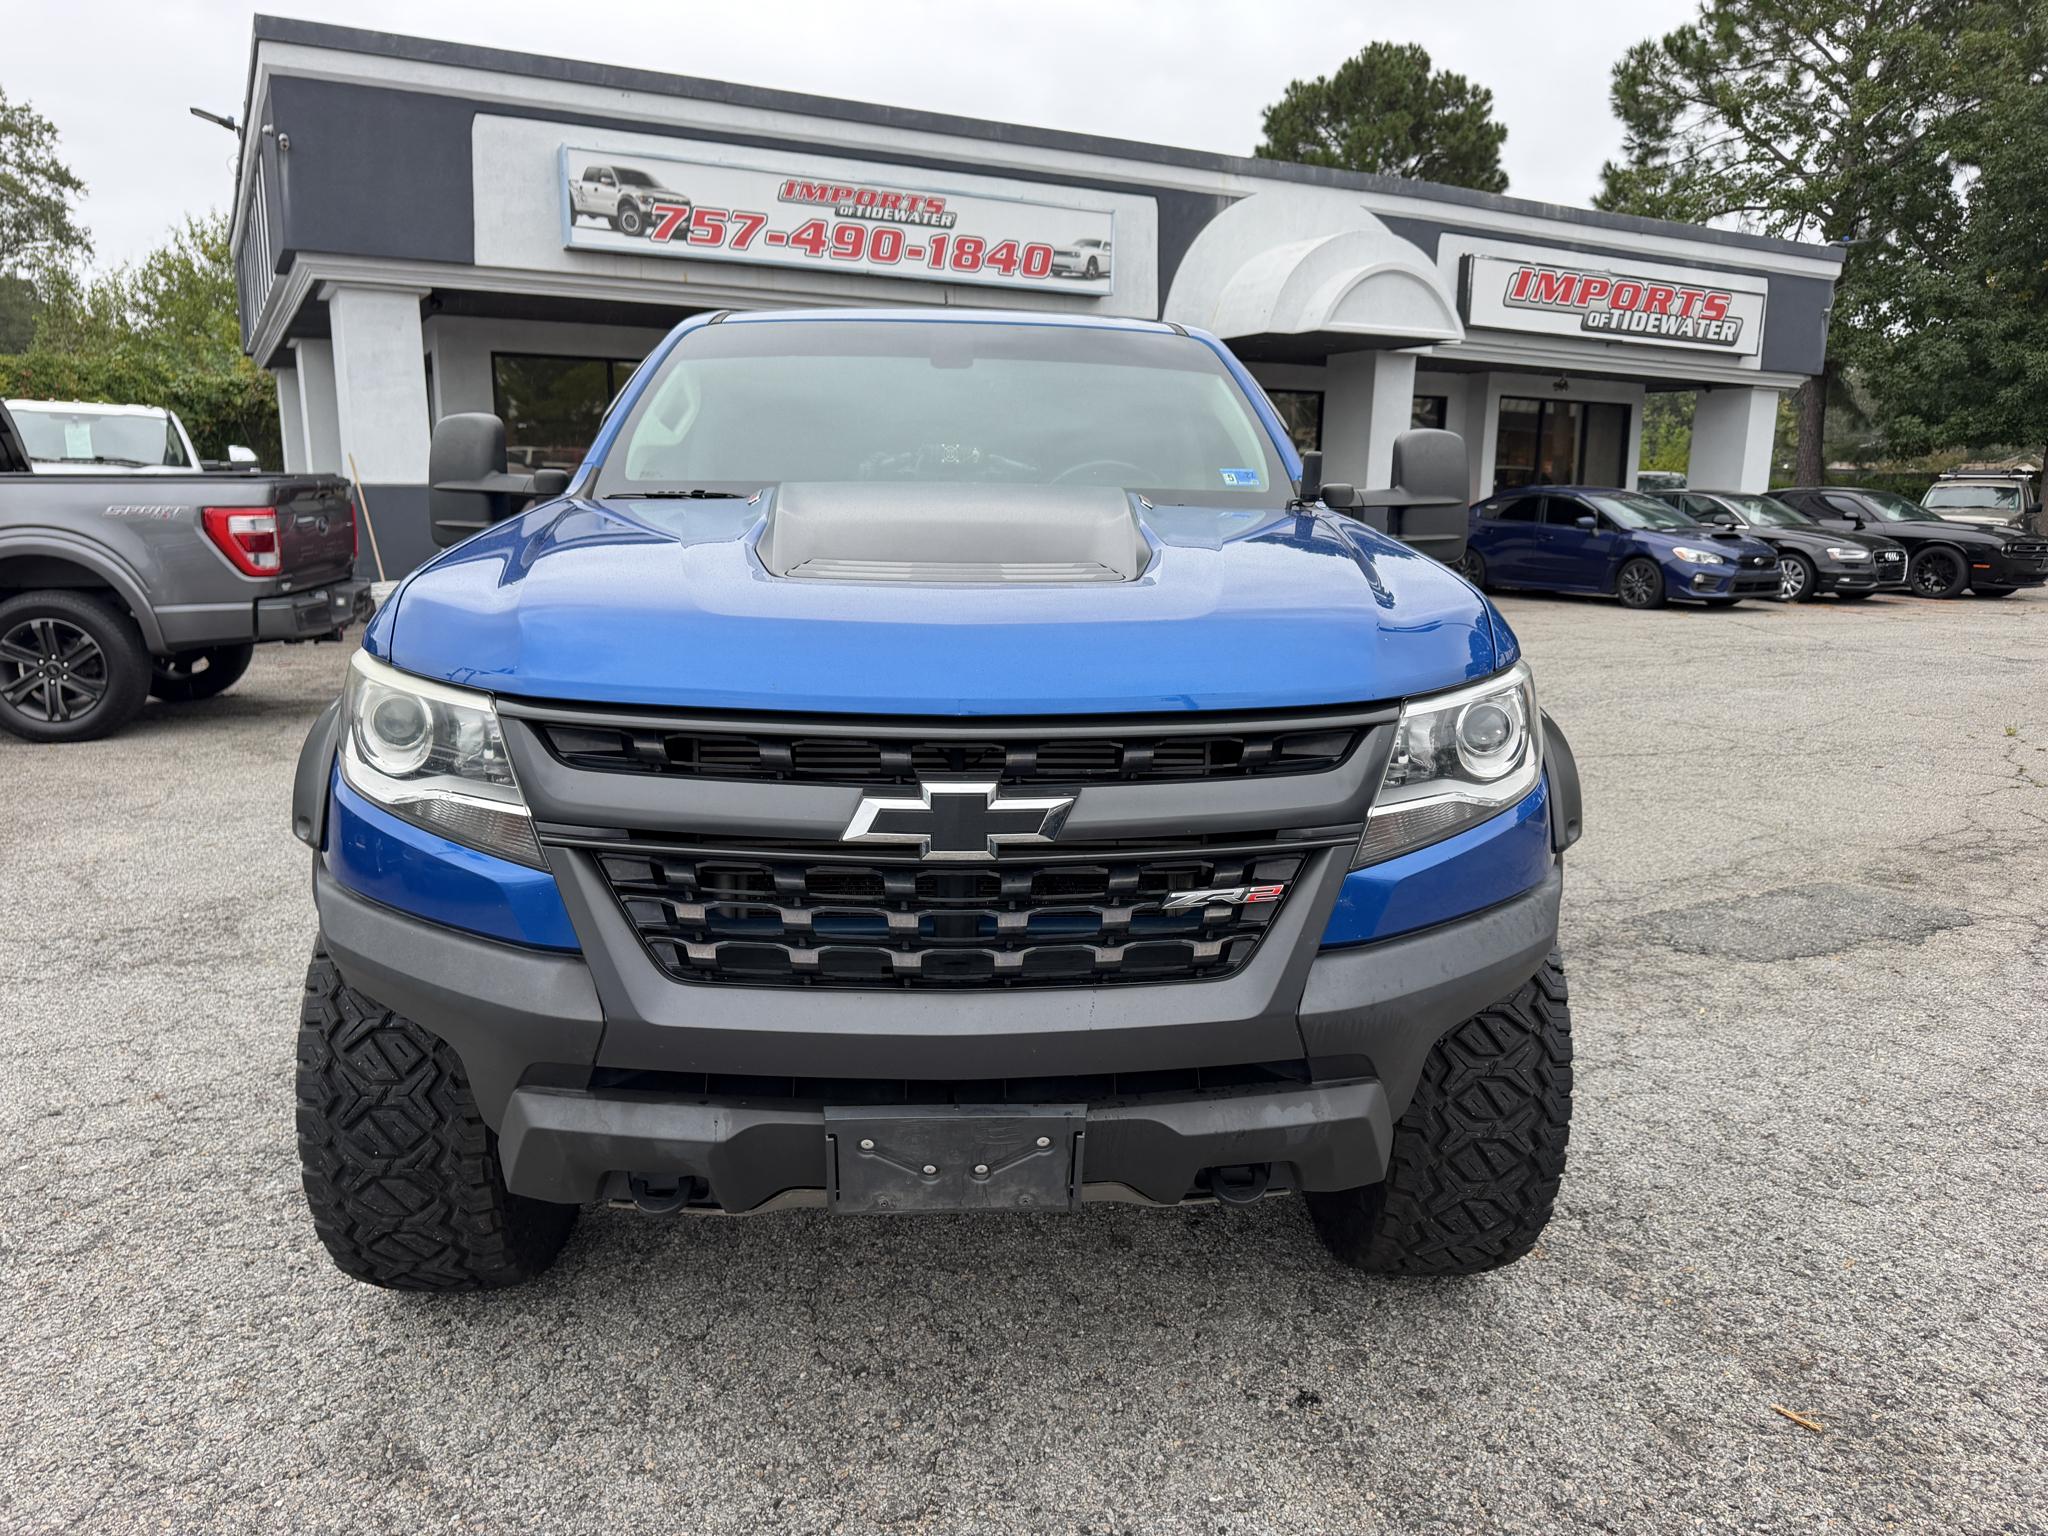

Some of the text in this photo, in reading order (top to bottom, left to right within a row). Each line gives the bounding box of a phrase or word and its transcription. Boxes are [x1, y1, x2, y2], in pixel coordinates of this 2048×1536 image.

[780, 179, 947, 214] IMPORTS
[839, 203, 954, 227] OF TIDEWATER
[651, 203, 1054, 279] 757-490-1840
[1512, 268, 1733, 321] IMPORTS
[1586, 308, 1738, 342] OF TIDEWATER
[1162, 884, 1285, 910] ZR2
